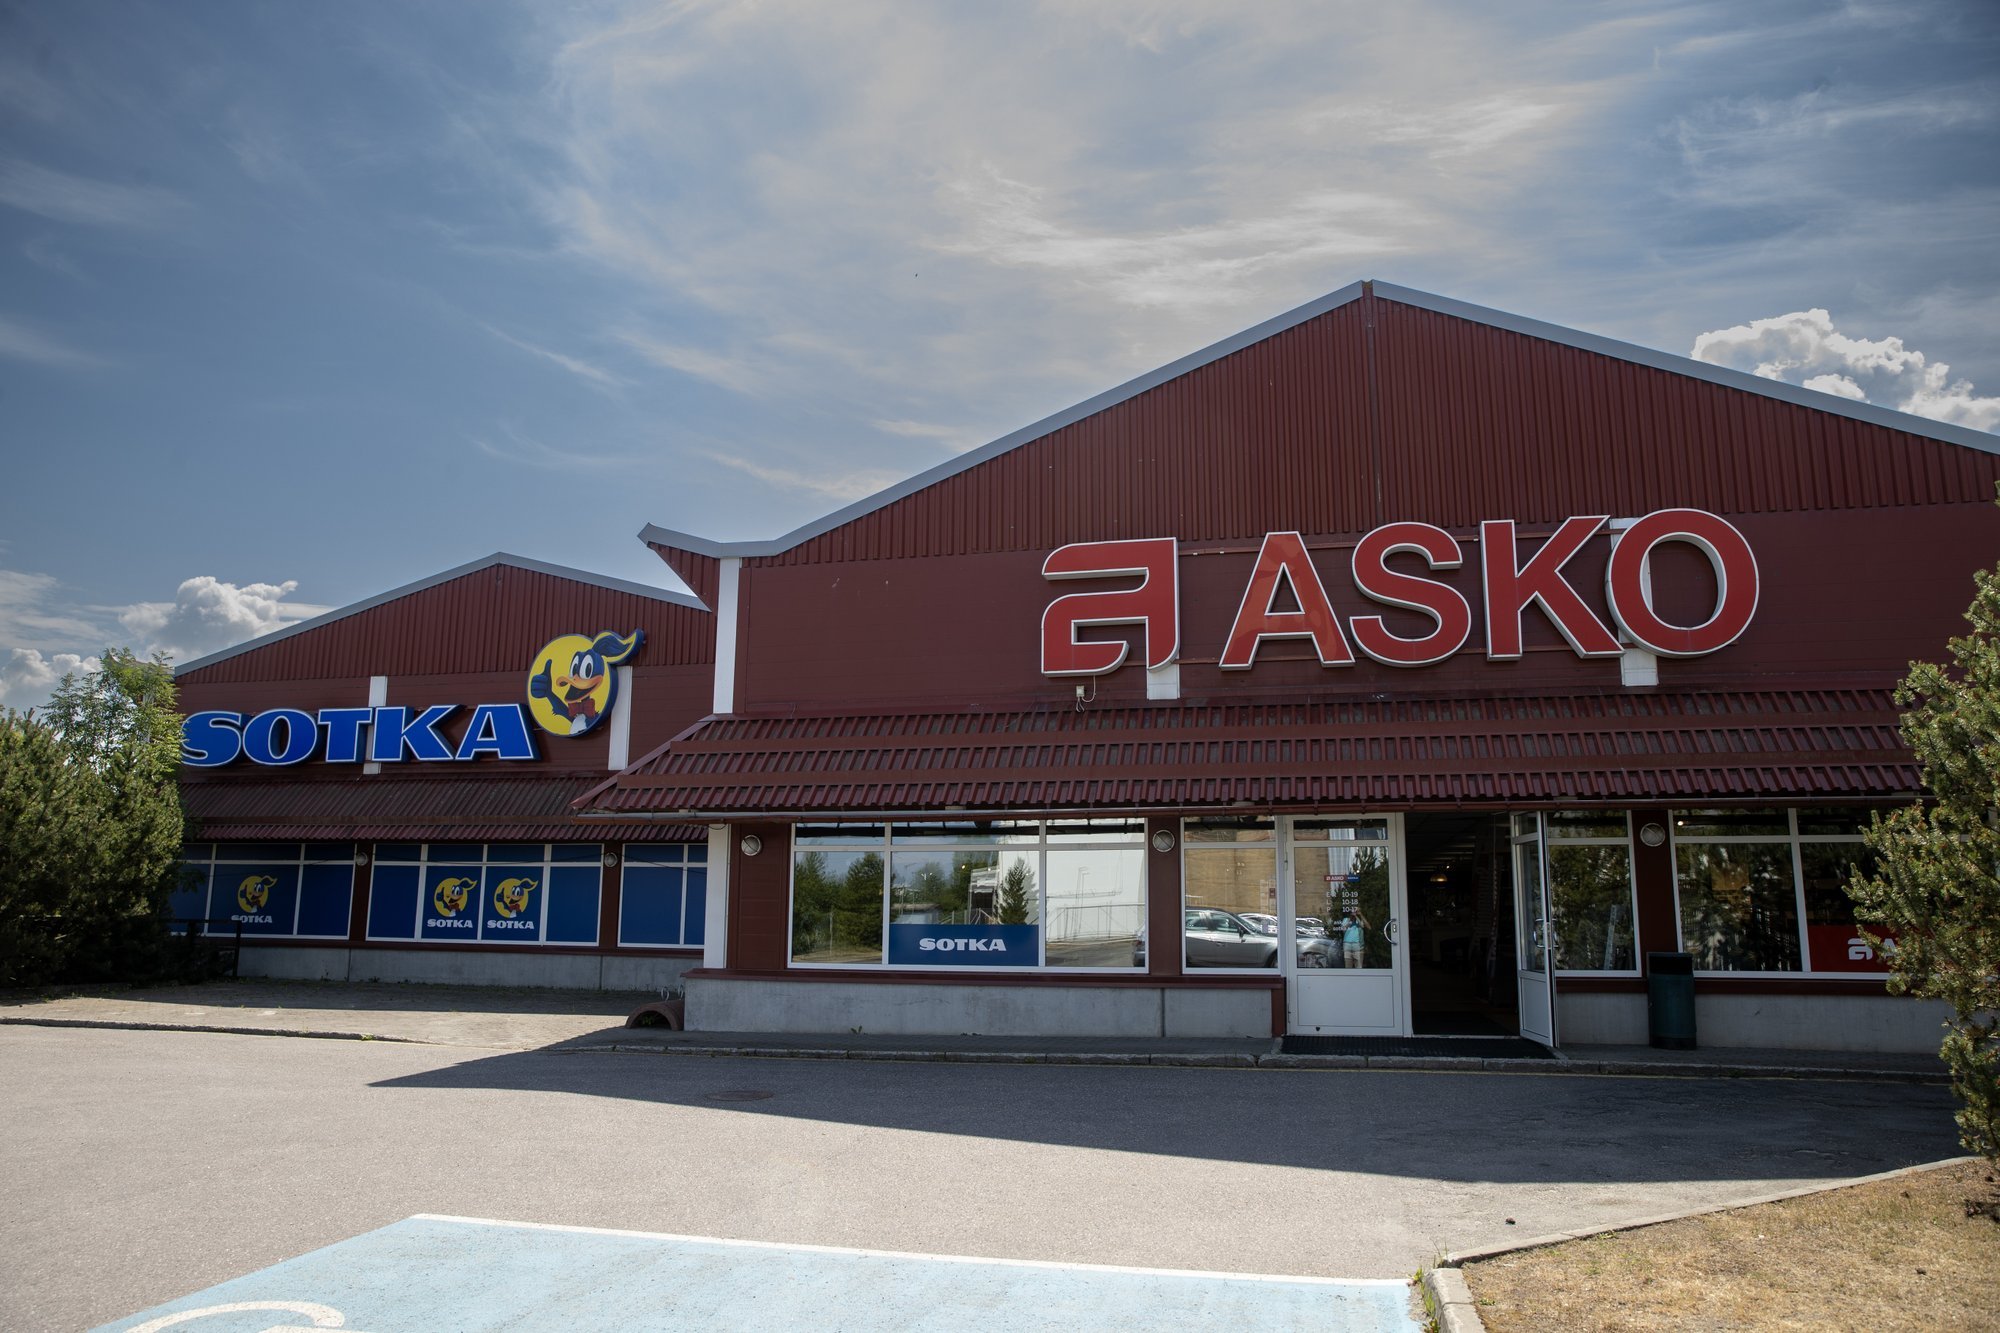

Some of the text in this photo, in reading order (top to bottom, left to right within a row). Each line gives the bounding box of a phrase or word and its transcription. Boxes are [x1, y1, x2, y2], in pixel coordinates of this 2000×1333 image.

[1219, 508, 1759, 671] ASKO
[181, 704, 538, 767] SOTKA
[427, 918, 473, 928] SOTKA
[487, 919, 535, 929] SOTKA
[919, 938, 1007, 951] SOTKA
